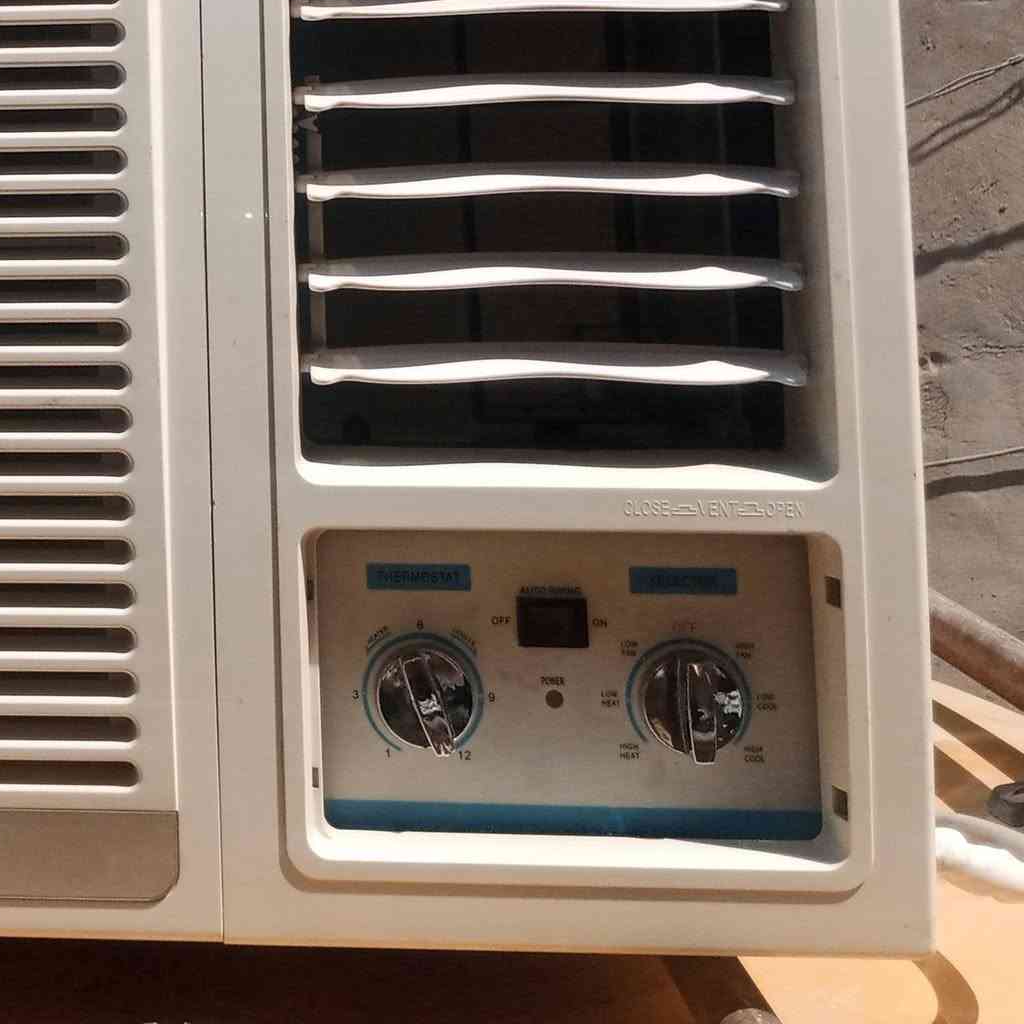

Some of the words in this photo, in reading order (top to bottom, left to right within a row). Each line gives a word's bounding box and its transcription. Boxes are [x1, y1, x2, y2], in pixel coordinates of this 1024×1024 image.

[624, 499, 672, 518] CLOSE
[696, 499, 740, 519] VENT
[764, 501, 805, 519] OPEN
[491, 615, 512, 625] OFF
[592, 618, 608, 628] ON
[352, 689, 360, 700] 3
[488, 691, 496, 702] 9
[385, 748, 391, 758] 1
[458, 750, 471, 761] 12
